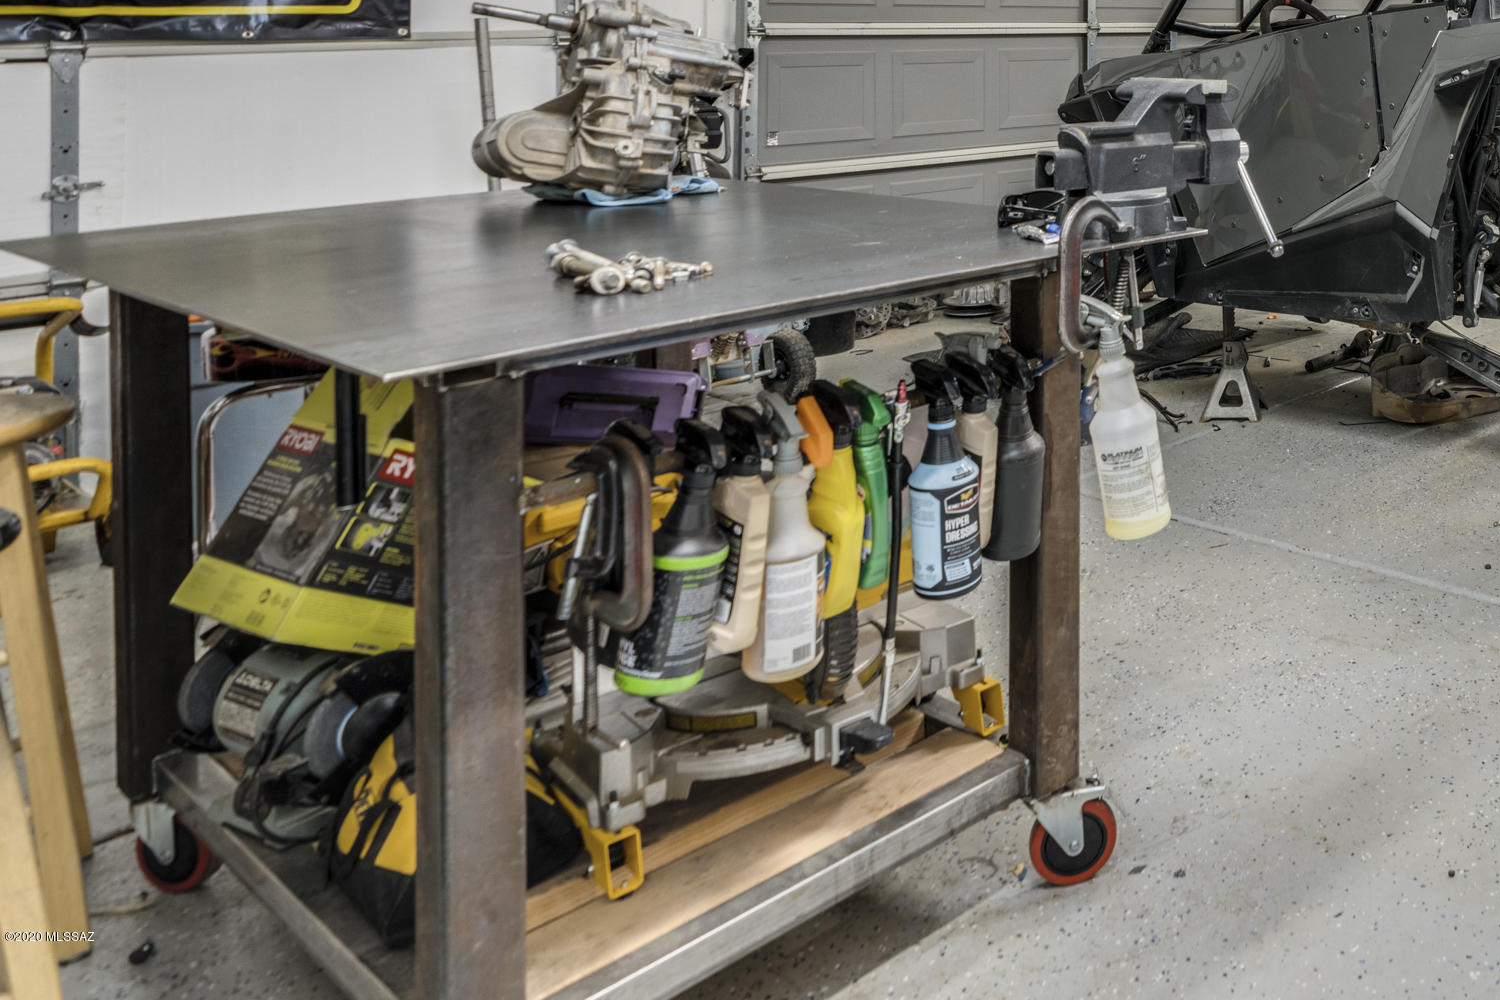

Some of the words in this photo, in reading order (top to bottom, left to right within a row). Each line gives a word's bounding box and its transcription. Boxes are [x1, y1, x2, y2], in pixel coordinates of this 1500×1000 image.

[280, 428, 321, 452] RYOBI
[945, 513, 970, 532] HYPER
[946, 520, 978, 543] DRESSING
